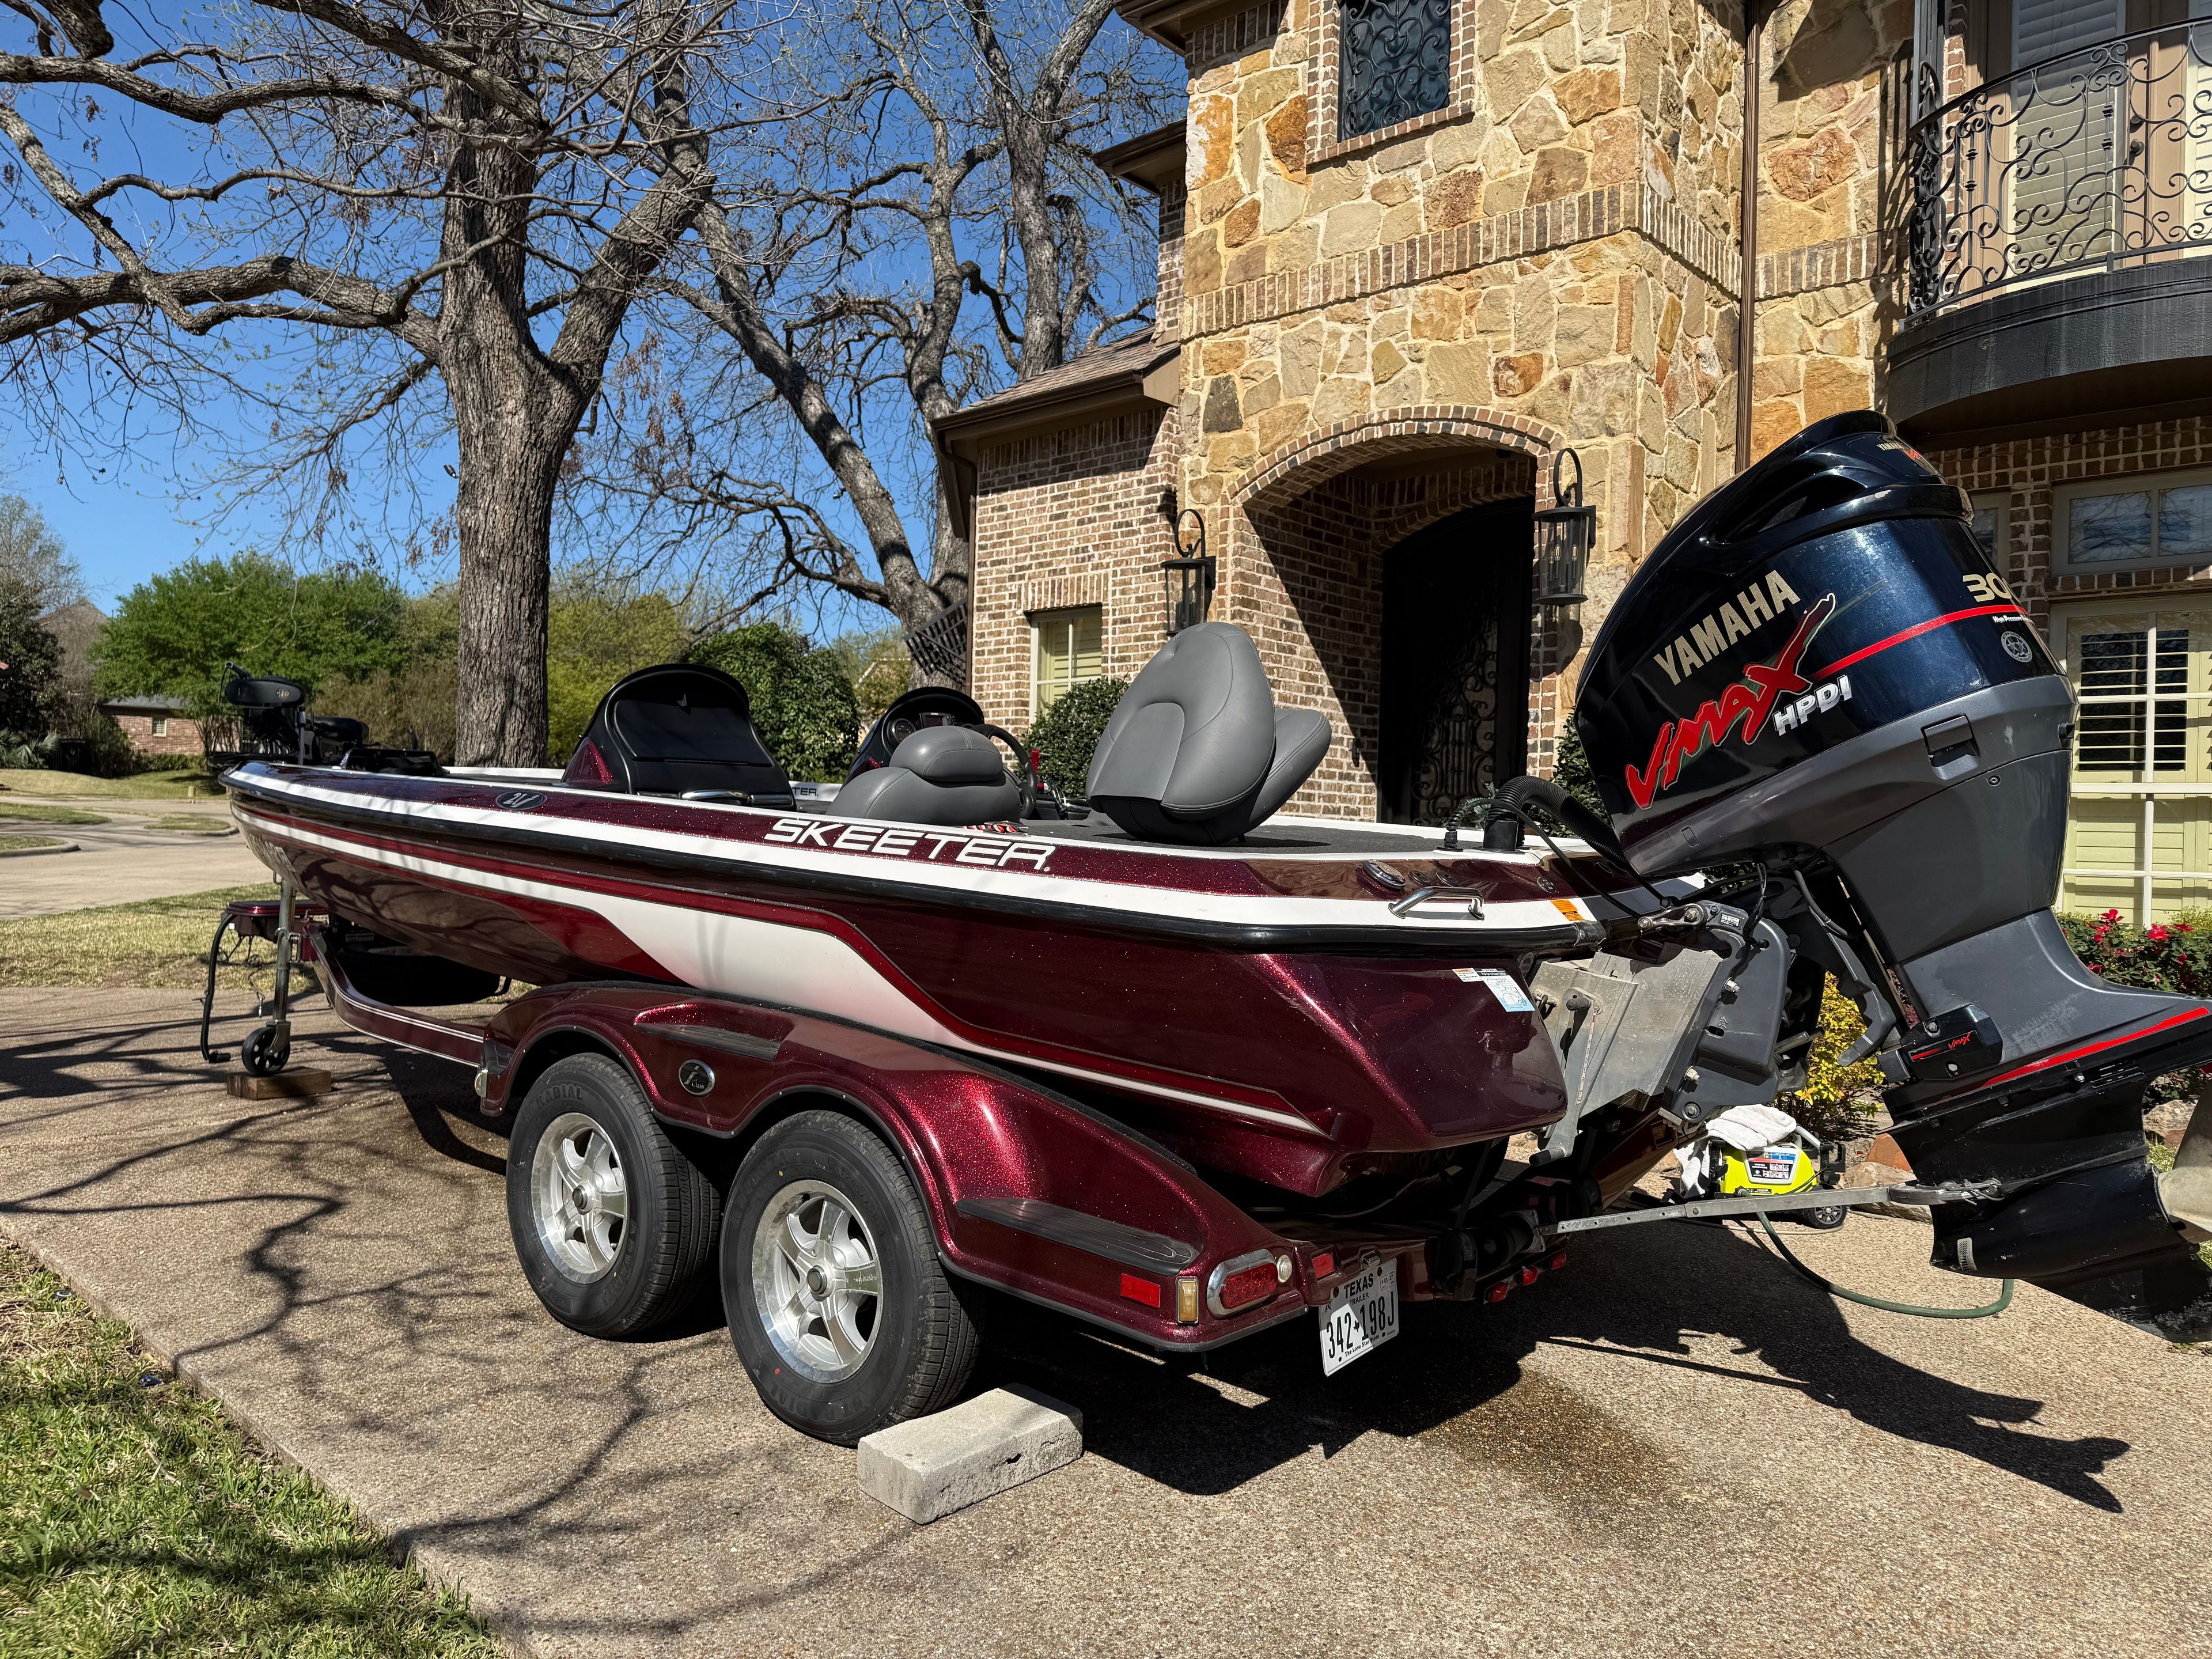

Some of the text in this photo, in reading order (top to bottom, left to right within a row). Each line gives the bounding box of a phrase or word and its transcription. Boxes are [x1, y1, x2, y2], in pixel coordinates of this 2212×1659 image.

[1963, 573, 2020, 603] 30
[1653, 570, 1801, 685] YAMAHA
[1774, 675, 1852, 736] HPDI
[764, 819, 1056, 870] SKEETER
[535, 1084, 584, 1107] RADIAL
[691, 1078, 704, 1089] Class
[1344, 1272, 1373, 1298] TEXAS
[1350, 1292, 1369, 1306] TRAILER
